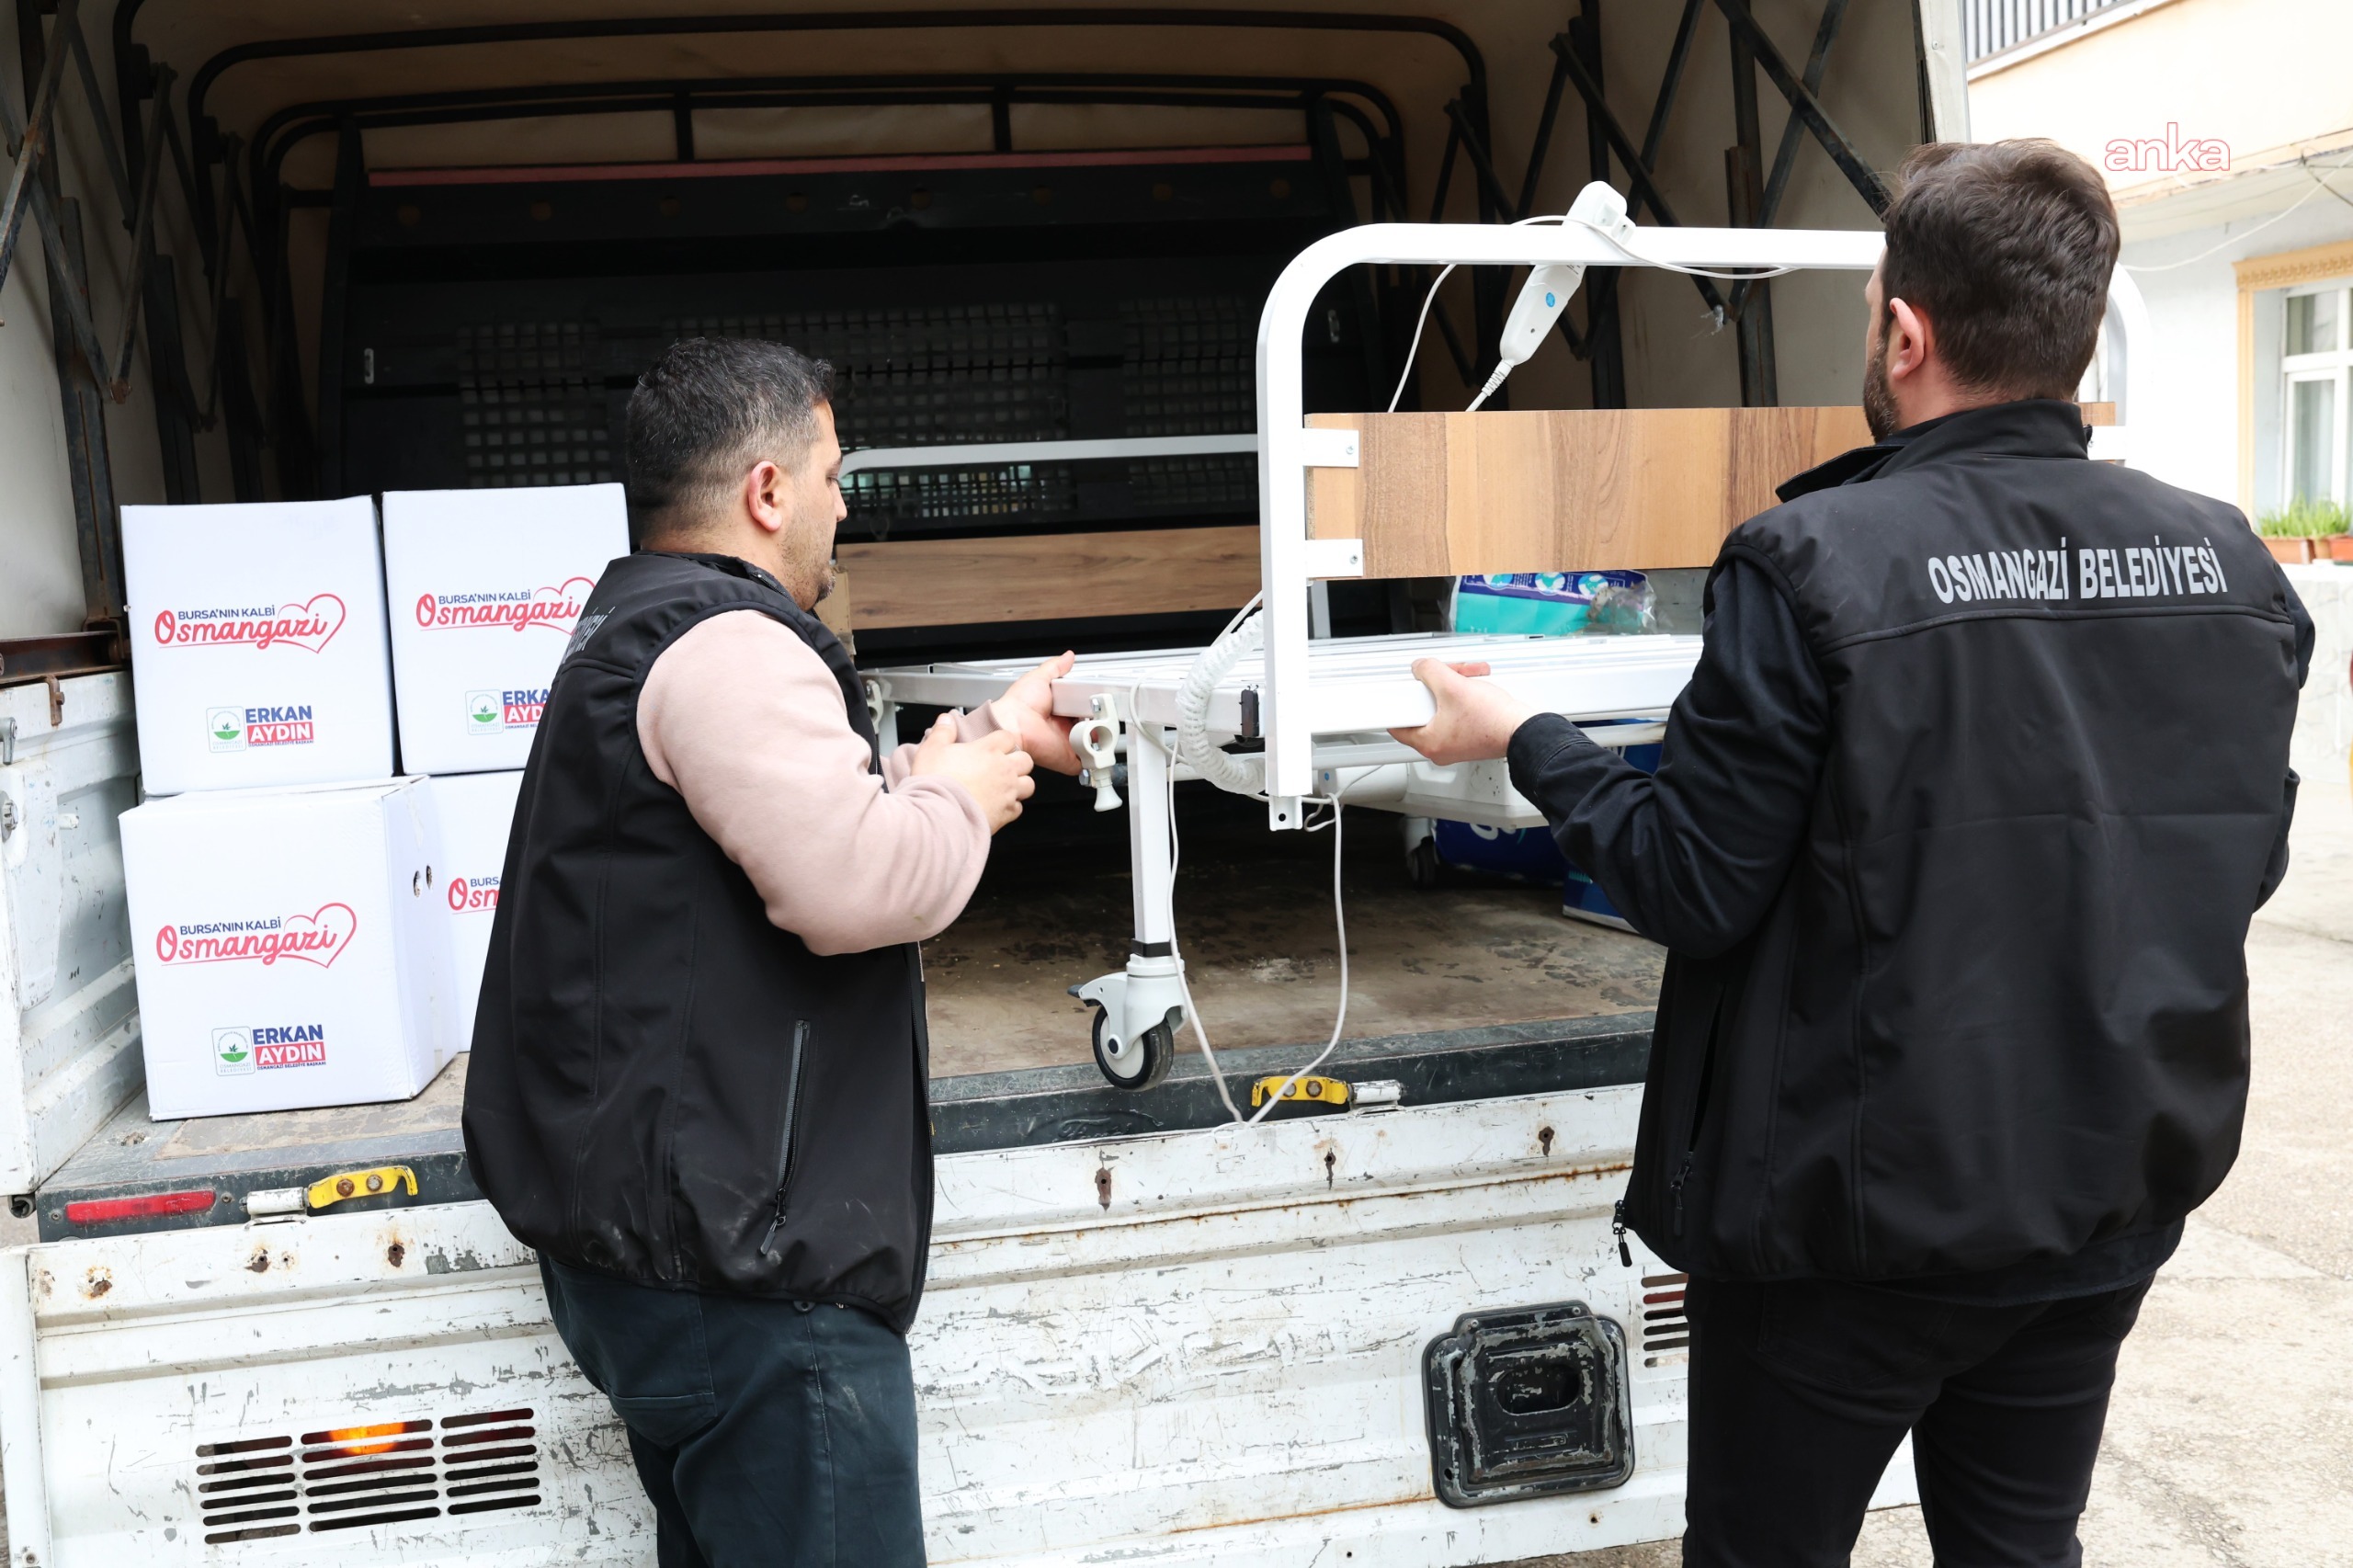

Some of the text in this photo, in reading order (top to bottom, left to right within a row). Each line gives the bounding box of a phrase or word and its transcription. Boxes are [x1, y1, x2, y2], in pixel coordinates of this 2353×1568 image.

[1927, 535, 2228, 604] OSMANGAZİ BELEDİYESİ
[438, 588, 531, 605] BURSA'NIN KALBİ
[177, 604, 276, 620] BURSA'NIN KALBİ
[415, 593, 581, 632] Osmangazi
[154, 609, 328, 650] Osmangazi
[502, 688, 551, 706] ERKA
[244, 705, 313, 723] ERKAN
[506, 705, 544, 722] AYD
[249, 722, 311, 743] AYDIN
[470, 876, 500, 888] BURS
[180, 915, 281, 936] BURSA'NIN KALBİ
[155, 924, 337, 966] Osmangazi
[252, 1024, 324, 1045] ERKAN
[258, 1043, 323, 1065] AYDIN
